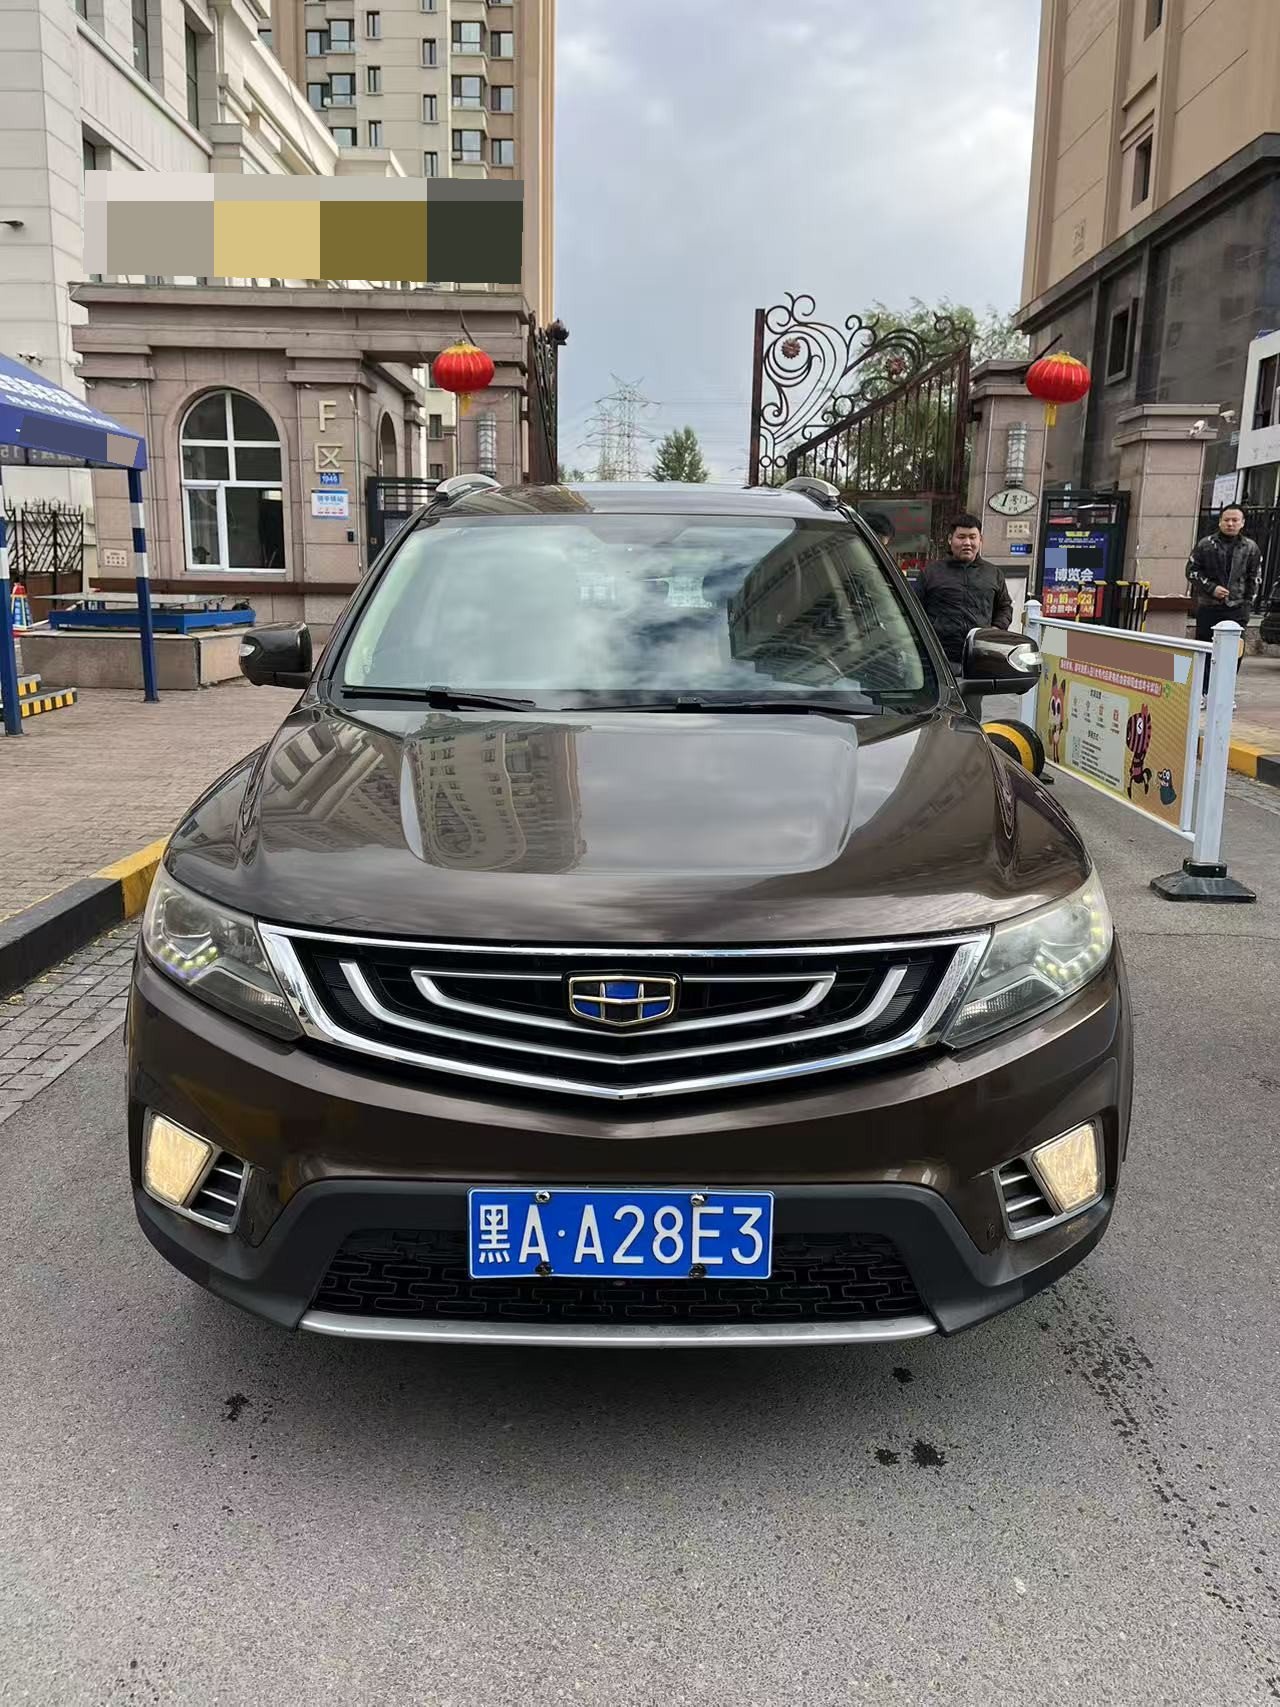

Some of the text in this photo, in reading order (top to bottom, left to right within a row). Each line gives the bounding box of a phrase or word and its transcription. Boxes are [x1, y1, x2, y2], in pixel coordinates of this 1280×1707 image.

[1055, 568, 1094, 581] 博览会
[478, 1204, 763, 1265] 黑A·A28E3
